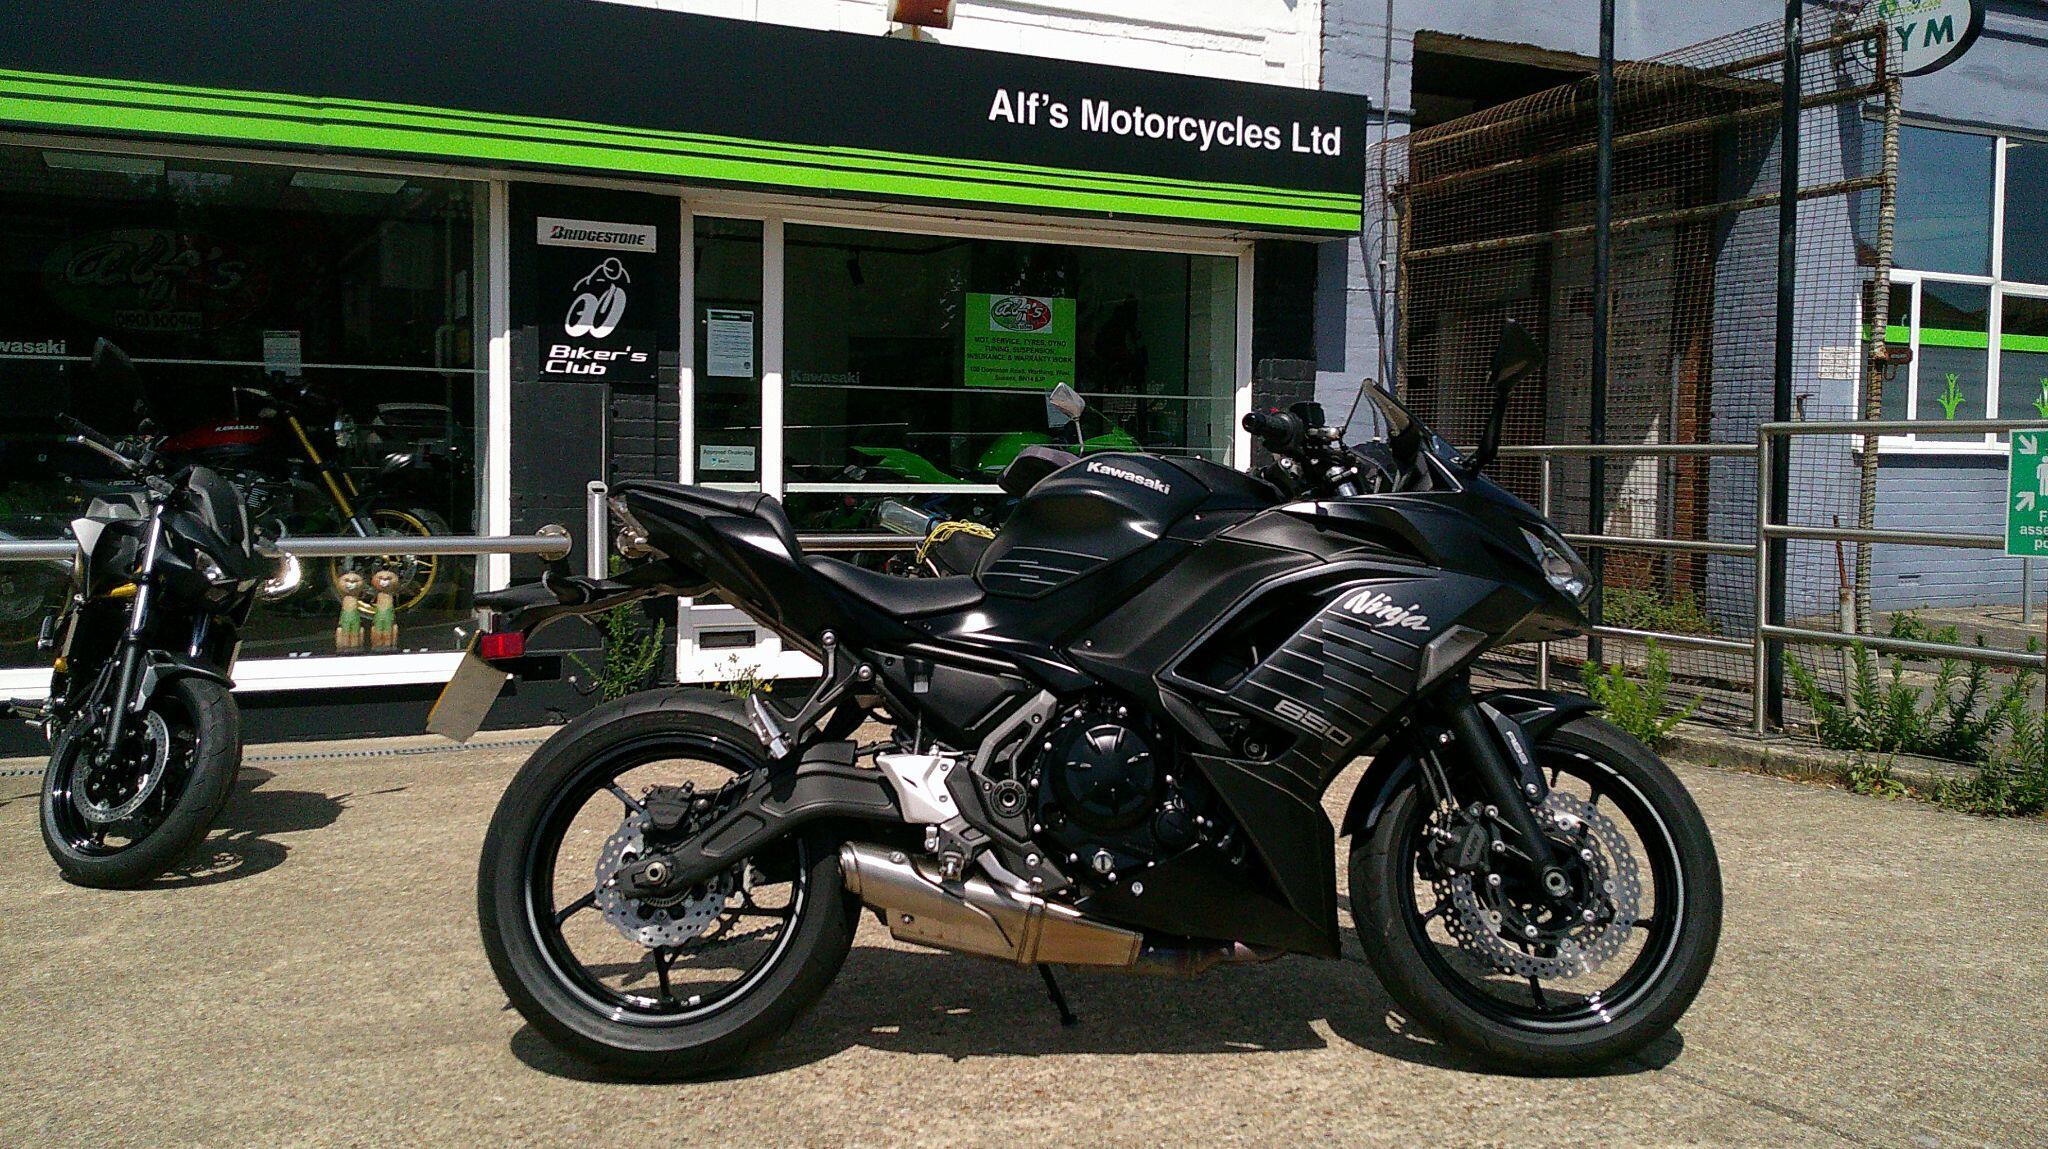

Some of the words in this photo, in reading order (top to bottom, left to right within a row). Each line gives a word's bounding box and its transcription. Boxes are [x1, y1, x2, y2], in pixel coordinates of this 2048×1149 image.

[988, 88, 1069, 129] Alf's
[1081, 98, 1281, 151] Motorcycles
[1292, 121, 1341, 156] Ltd
[551, 225, 646, 246] BRIDGESTONE
[549, 345, 648, 362] Biker's
[545, 360, 607, 375] Club
[791, 369, 860, 384] Kawasaki
[1086, 461, 1171, 495] Kawasaki
[1343, 590, 1431, 630] Ninja
[1273, 699, 1353, 747] 650
